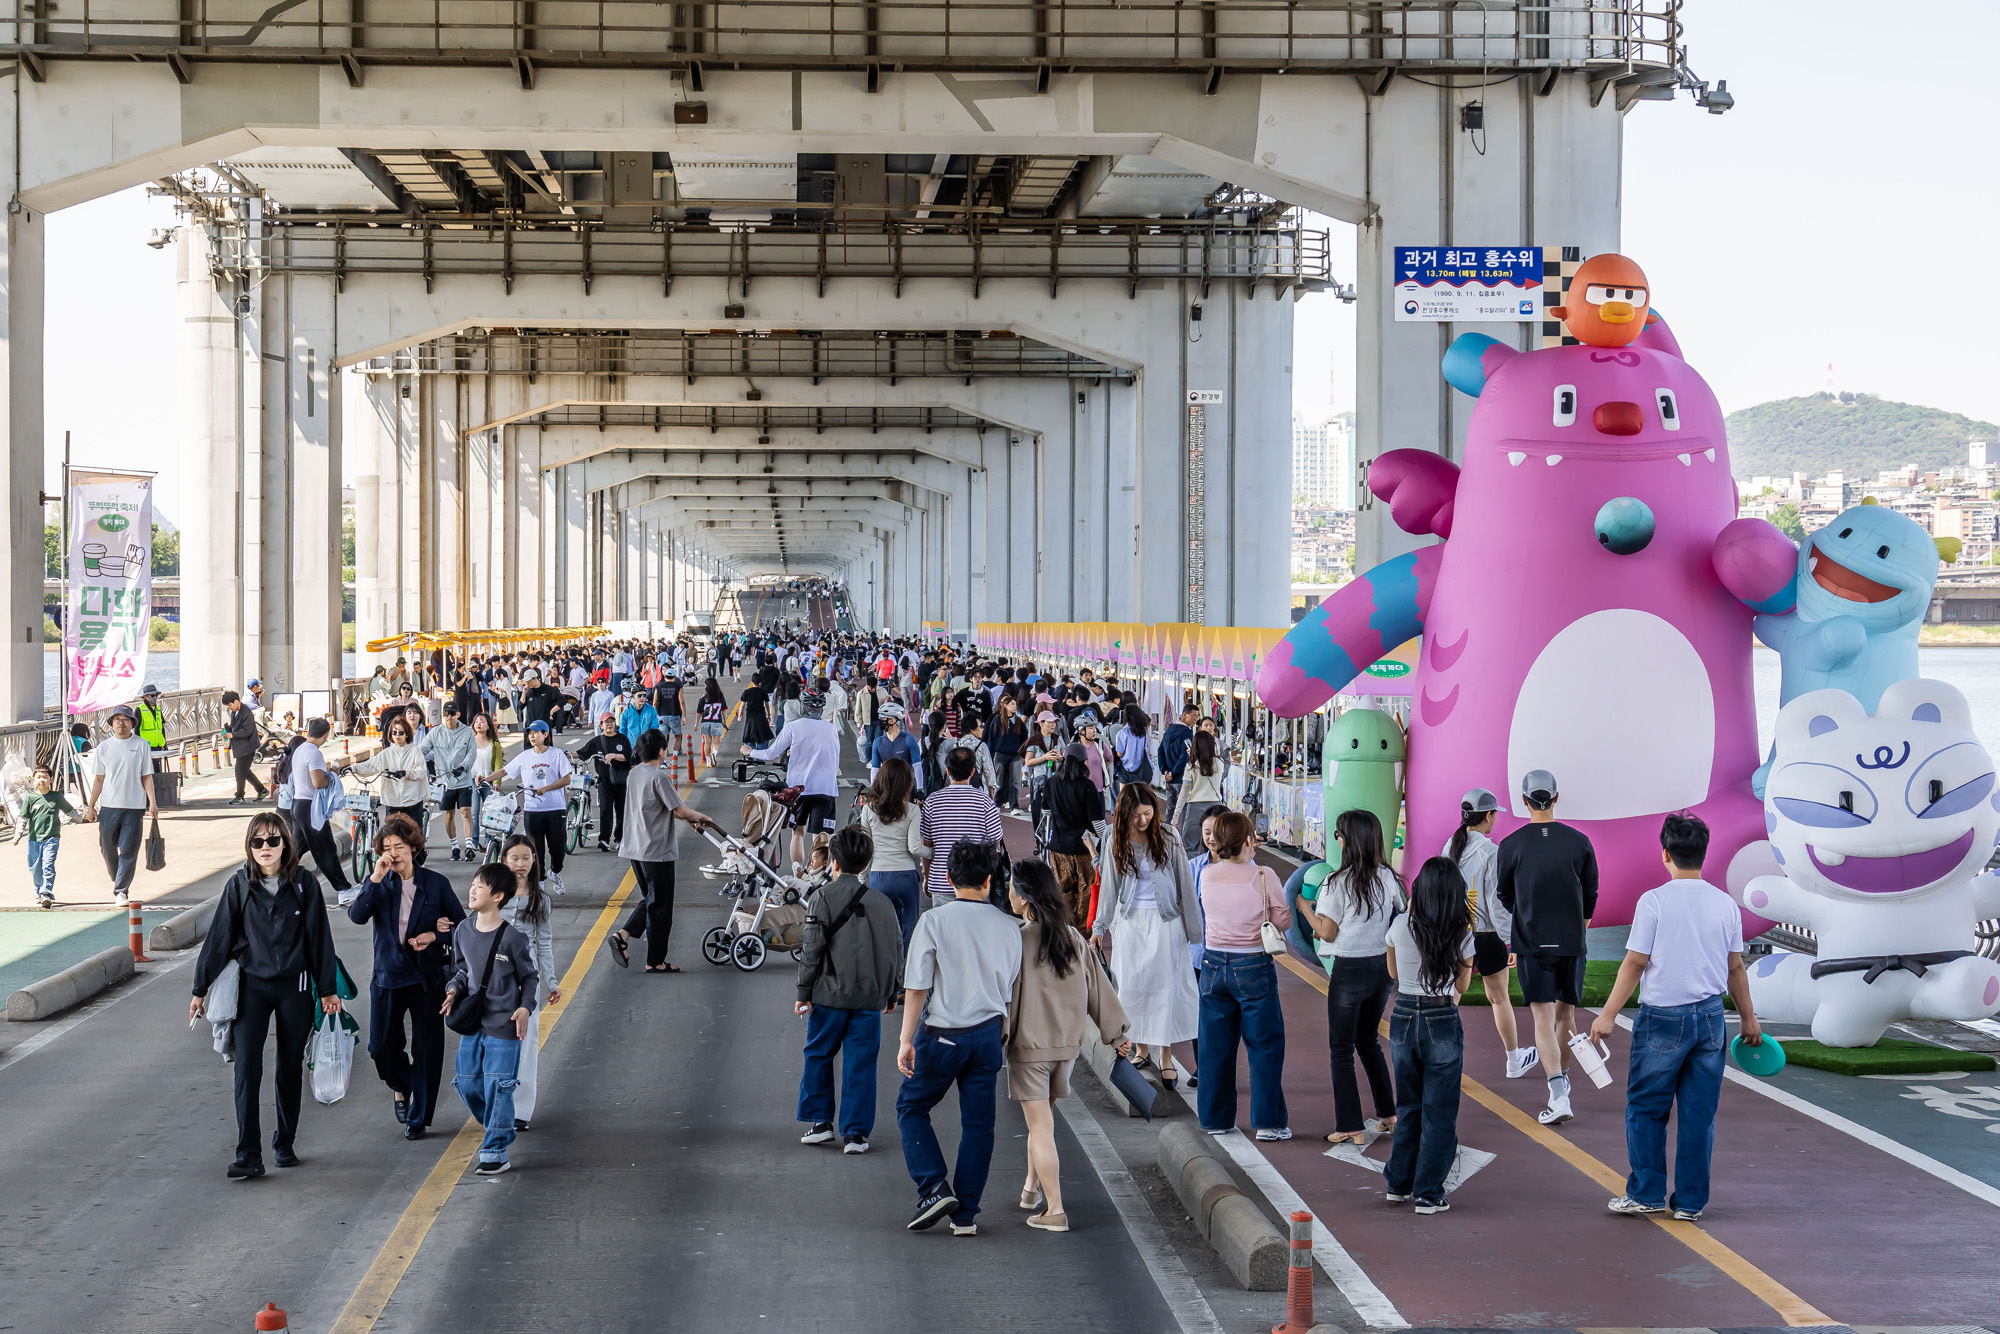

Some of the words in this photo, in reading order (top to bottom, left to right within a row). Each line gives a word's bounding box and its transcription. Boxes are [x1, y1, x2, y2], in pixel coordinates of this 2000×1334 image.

[1404, 250, 1436, 267] 과거
[1444, 250, 1478, 267] 최고
[1484, 250, 1534, 267] 홍수위
[1458, 270, 1476, 278] (해발
[1480, 270, 1513, 278] 13.63m)
[120, 502, 139, 512] 축제
[80, 586, 142, 618] 다회
[79, 620, 137, 652] 용기
[77, 655, 135, 678] 반납소
[920, 1194, 943, 1209] RADA
